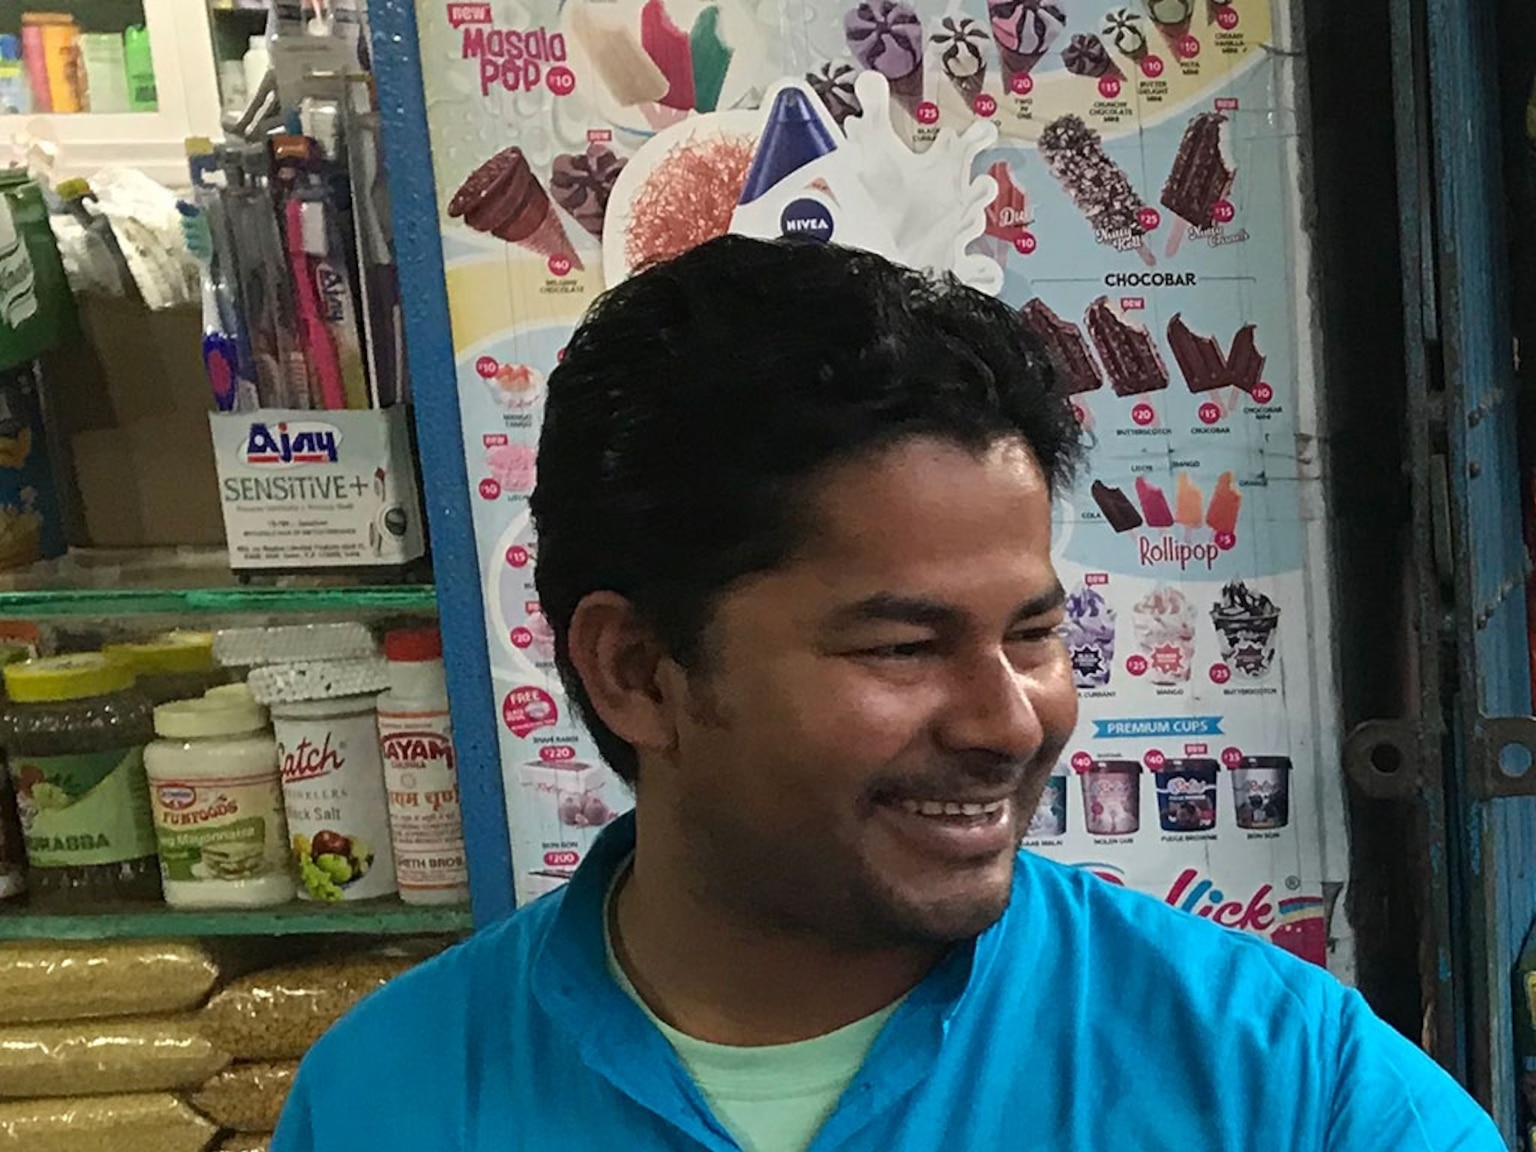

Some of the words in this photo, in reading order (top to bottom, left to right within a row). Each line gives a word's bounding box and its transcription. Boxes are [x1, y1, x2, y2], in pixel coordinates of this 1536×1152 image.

[786, 218, 829, 231] NIVEA
[1104, 272, 1197, 287] CHOCOBAR
[247, 421, 339, 463] Ajay
[1139, 536, 1219, 571] Rollipop
[1107, 721, 1170, 735] PREMIUM
[1173, 720, 1209, 733] CUPS
[383, 738, 455, 770] AYAM
[314, 806, 342, 821] Salt
